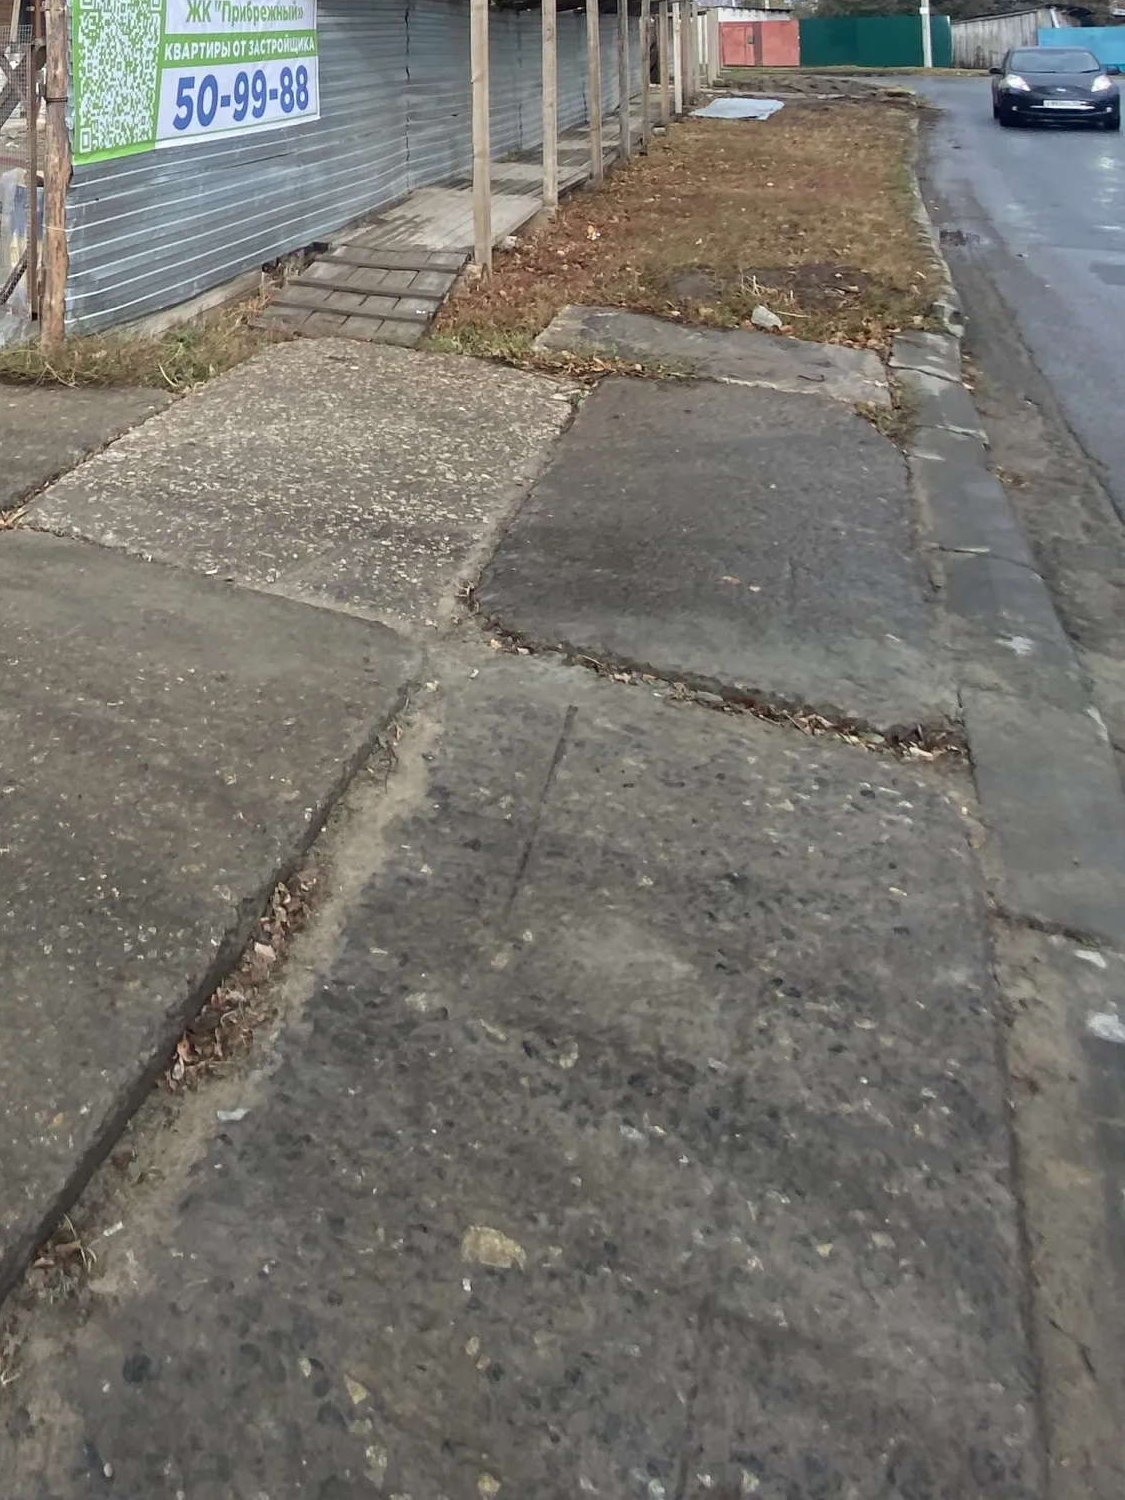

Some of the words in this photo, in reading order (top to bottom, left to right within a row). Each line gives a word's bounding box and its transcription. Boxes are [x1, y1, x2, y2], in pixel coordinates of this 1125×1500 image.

[185, 0, 212, 22] ЖК
[164, 40, 231, 61] КВАРТИРЫ
[233, 39, 247, 56] ОТ
[248, 34, 315, 56] ЗАСТРОЙЩИКА
[172, 64, 309, 131] 50-99-88
